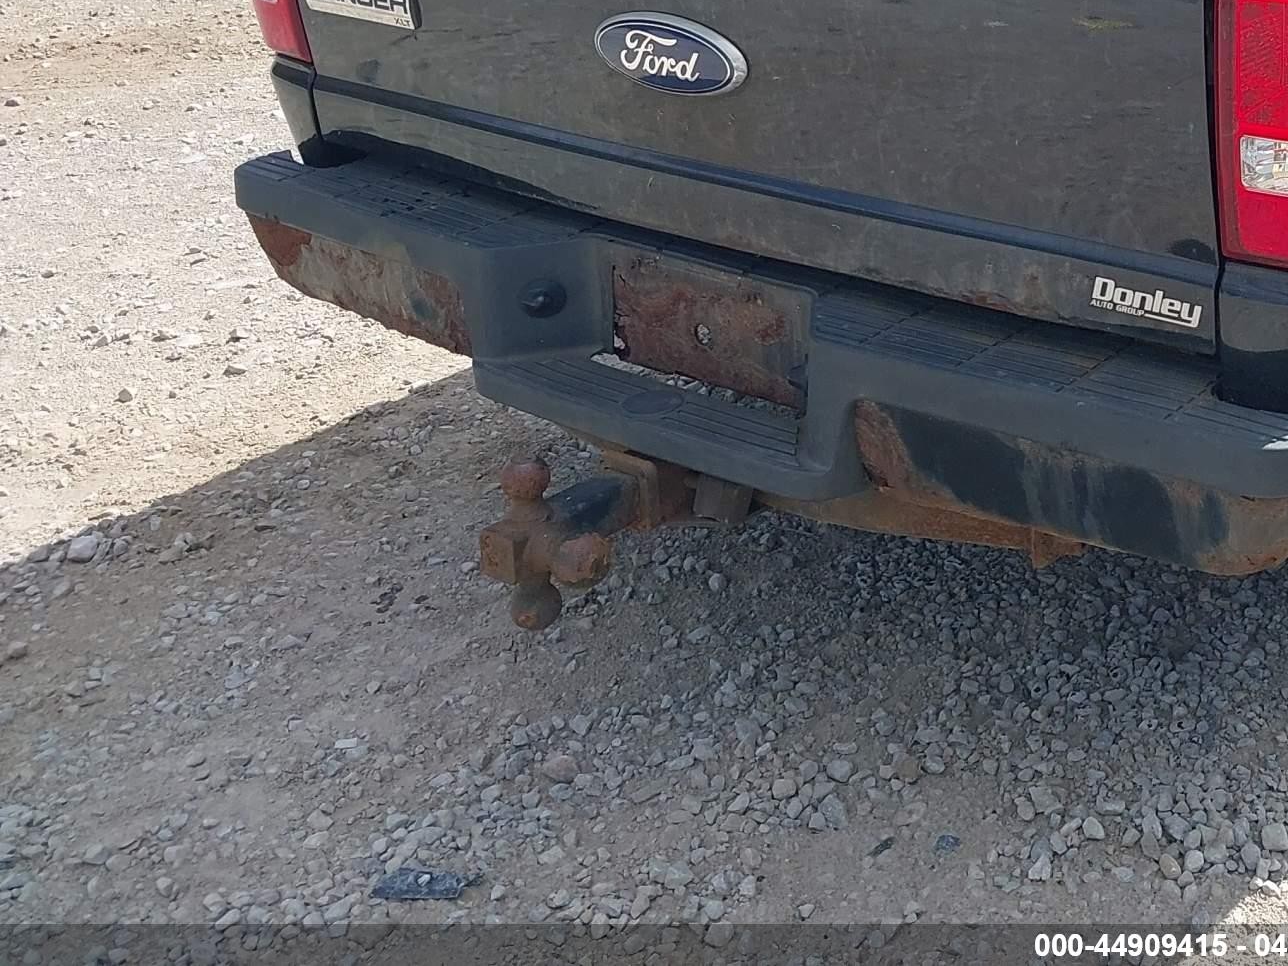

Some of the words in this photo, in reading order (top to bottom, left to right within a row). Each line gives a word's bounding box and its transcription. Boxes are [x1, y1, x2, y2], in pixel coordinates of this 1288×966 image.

[394, 17, 411, 27] XLT
[620, 29, 701, 82] Ford
[1090, 299, 1113, 310] AUTO
[1115, 305, 1145, 317] GROUP
[1092, 276, 1202, 327] Donley
